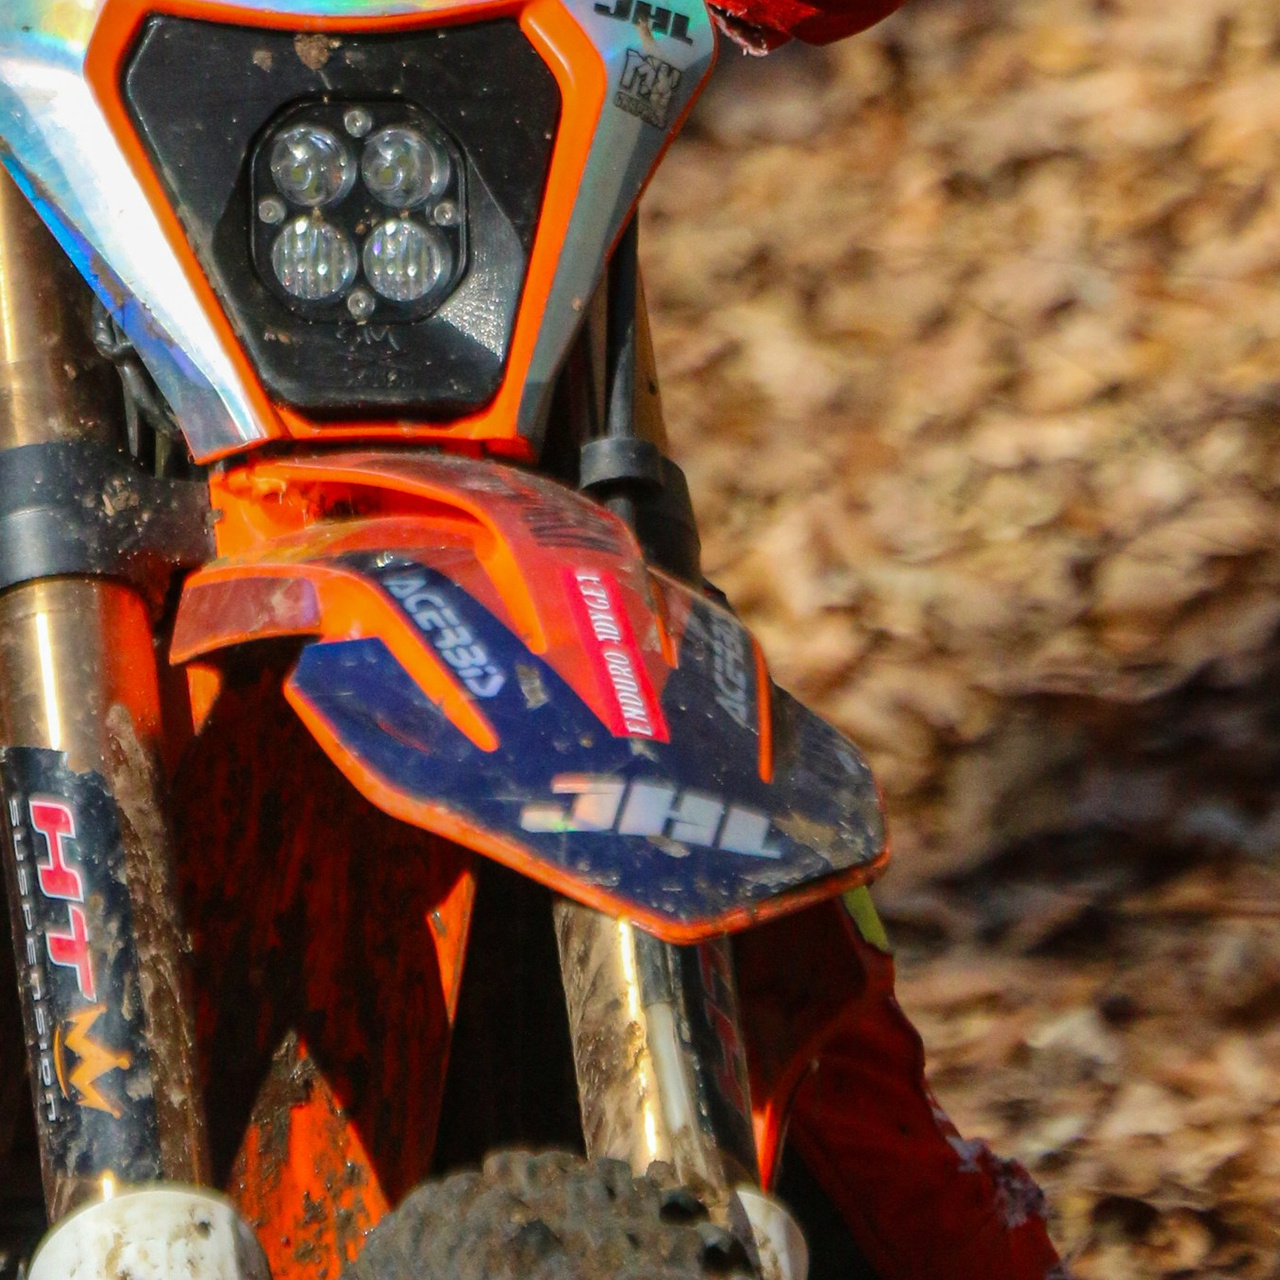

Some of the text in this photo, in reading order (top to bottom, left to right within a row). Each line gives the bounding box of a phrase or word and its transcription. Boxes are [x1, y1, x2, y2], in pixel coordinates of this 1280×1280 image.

[575, 573, 653, 736] ENDURO ADYGEA
[711, 608, 748, 729] ACERB
[521, 773, 782, 859] JHL
[28, 798, 97, 1002] HT
